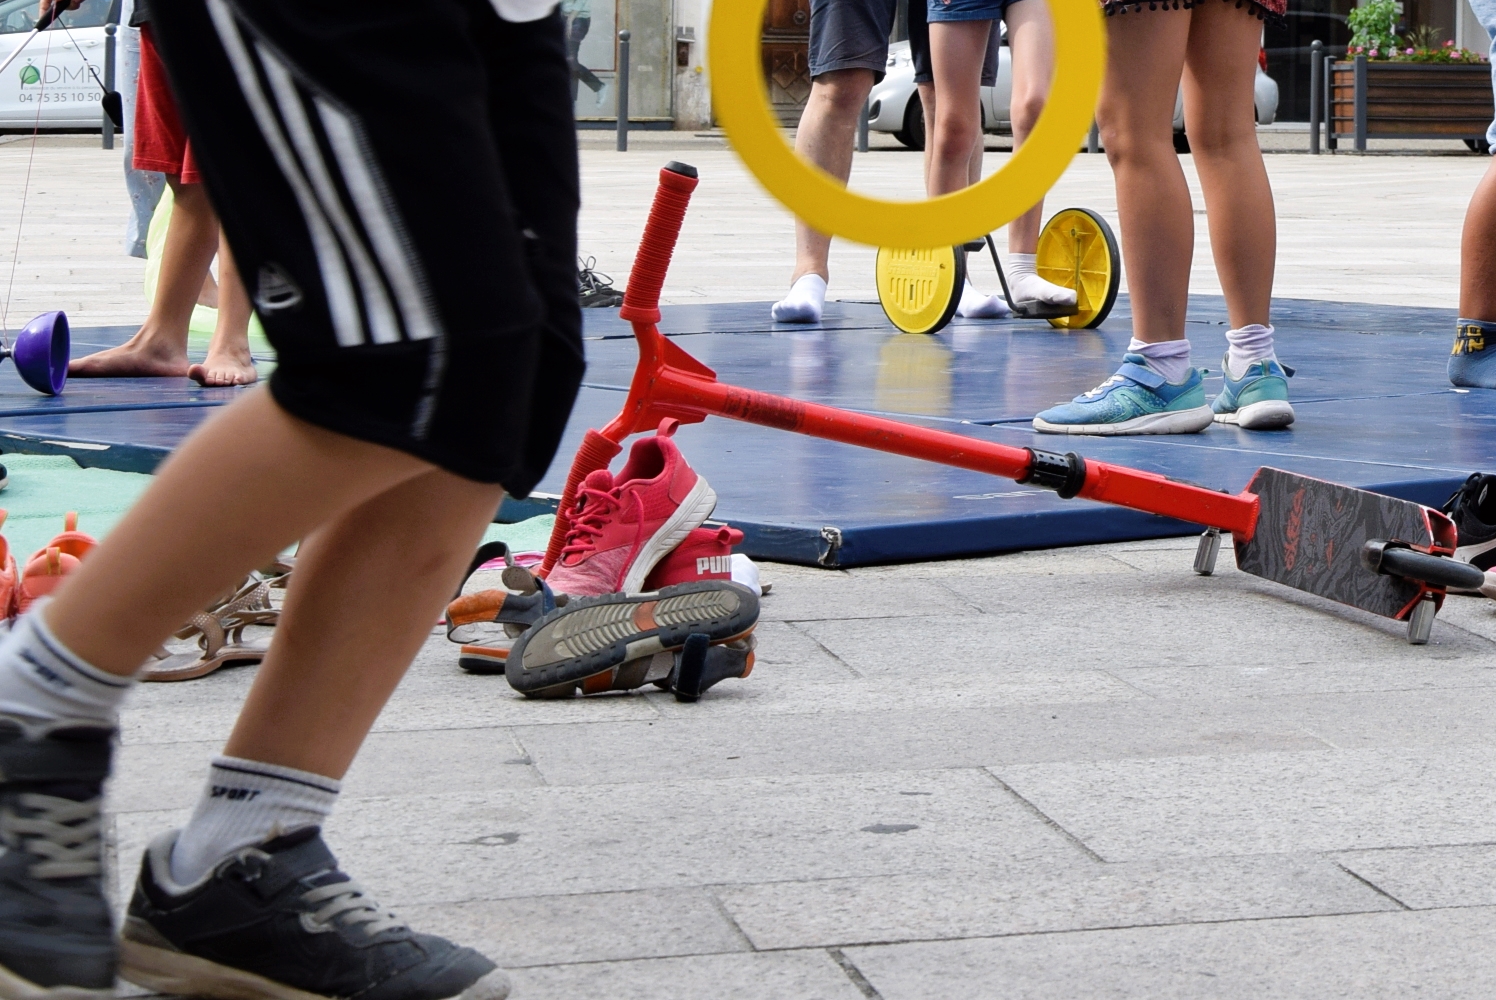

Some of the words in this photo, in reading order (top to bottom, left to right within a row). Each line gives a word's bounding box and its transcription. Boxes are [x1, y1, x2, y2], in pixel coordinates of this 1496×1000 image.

[19, 93, 33, 103] 04
[36, 93, 50, 103] 75
[53, 93, 67, 102] 35
[71, 92, 85, 102] 10
[87, 92, 102, 102] 50
[211, 785, 261, 801] SPORT
